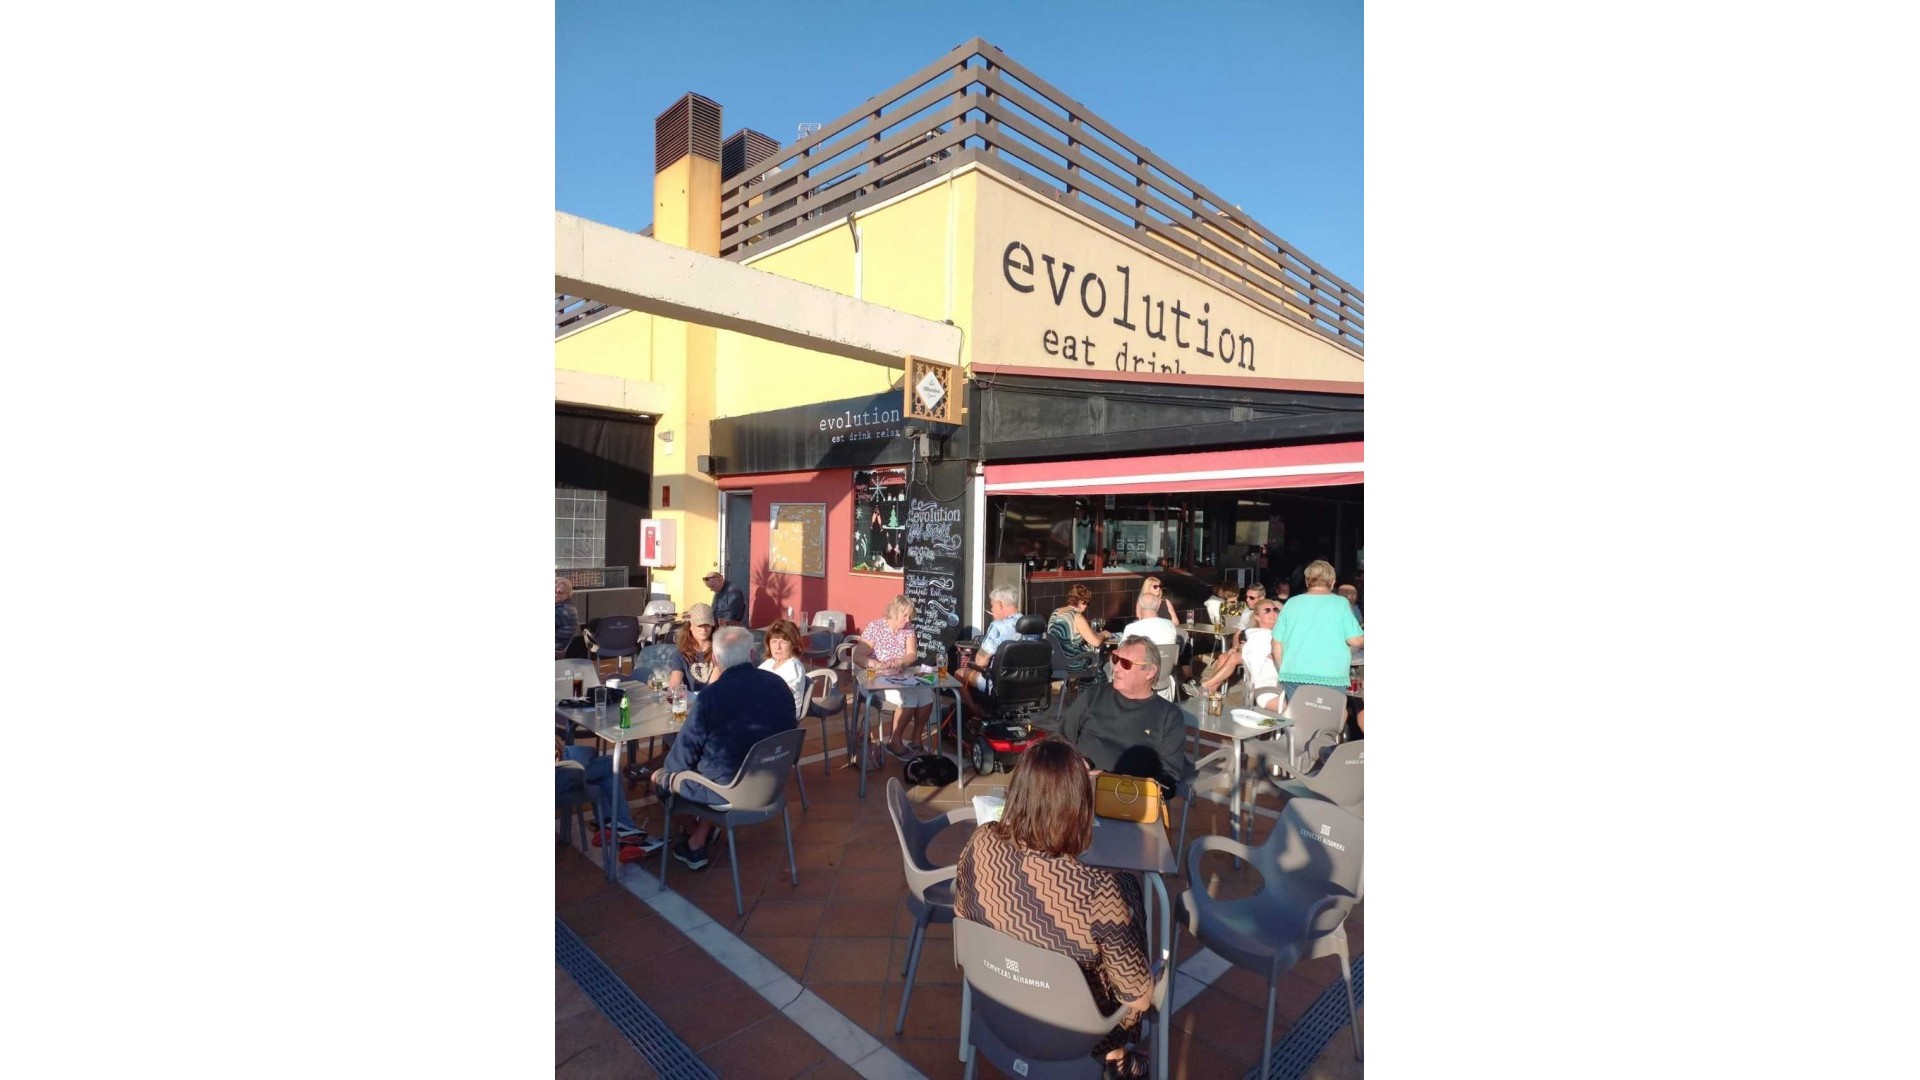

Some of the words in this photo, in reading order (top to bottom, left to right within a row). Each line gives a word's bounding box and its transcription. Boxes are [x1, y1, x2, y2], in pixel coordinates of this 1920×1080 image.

[1002, 241, 1256, 372] evolution
[1043, 329, 1096, 366] eat
[819, 406, 900, 431] evolution
[831, 434, 845, 443] eat
[849, 430, 872, 441] drink
[876, 428, 901, 439] relax
[983, 959, 1011, 979] CERVEZAS
[1013, 974, 1050, 989] ALHAMBRA
